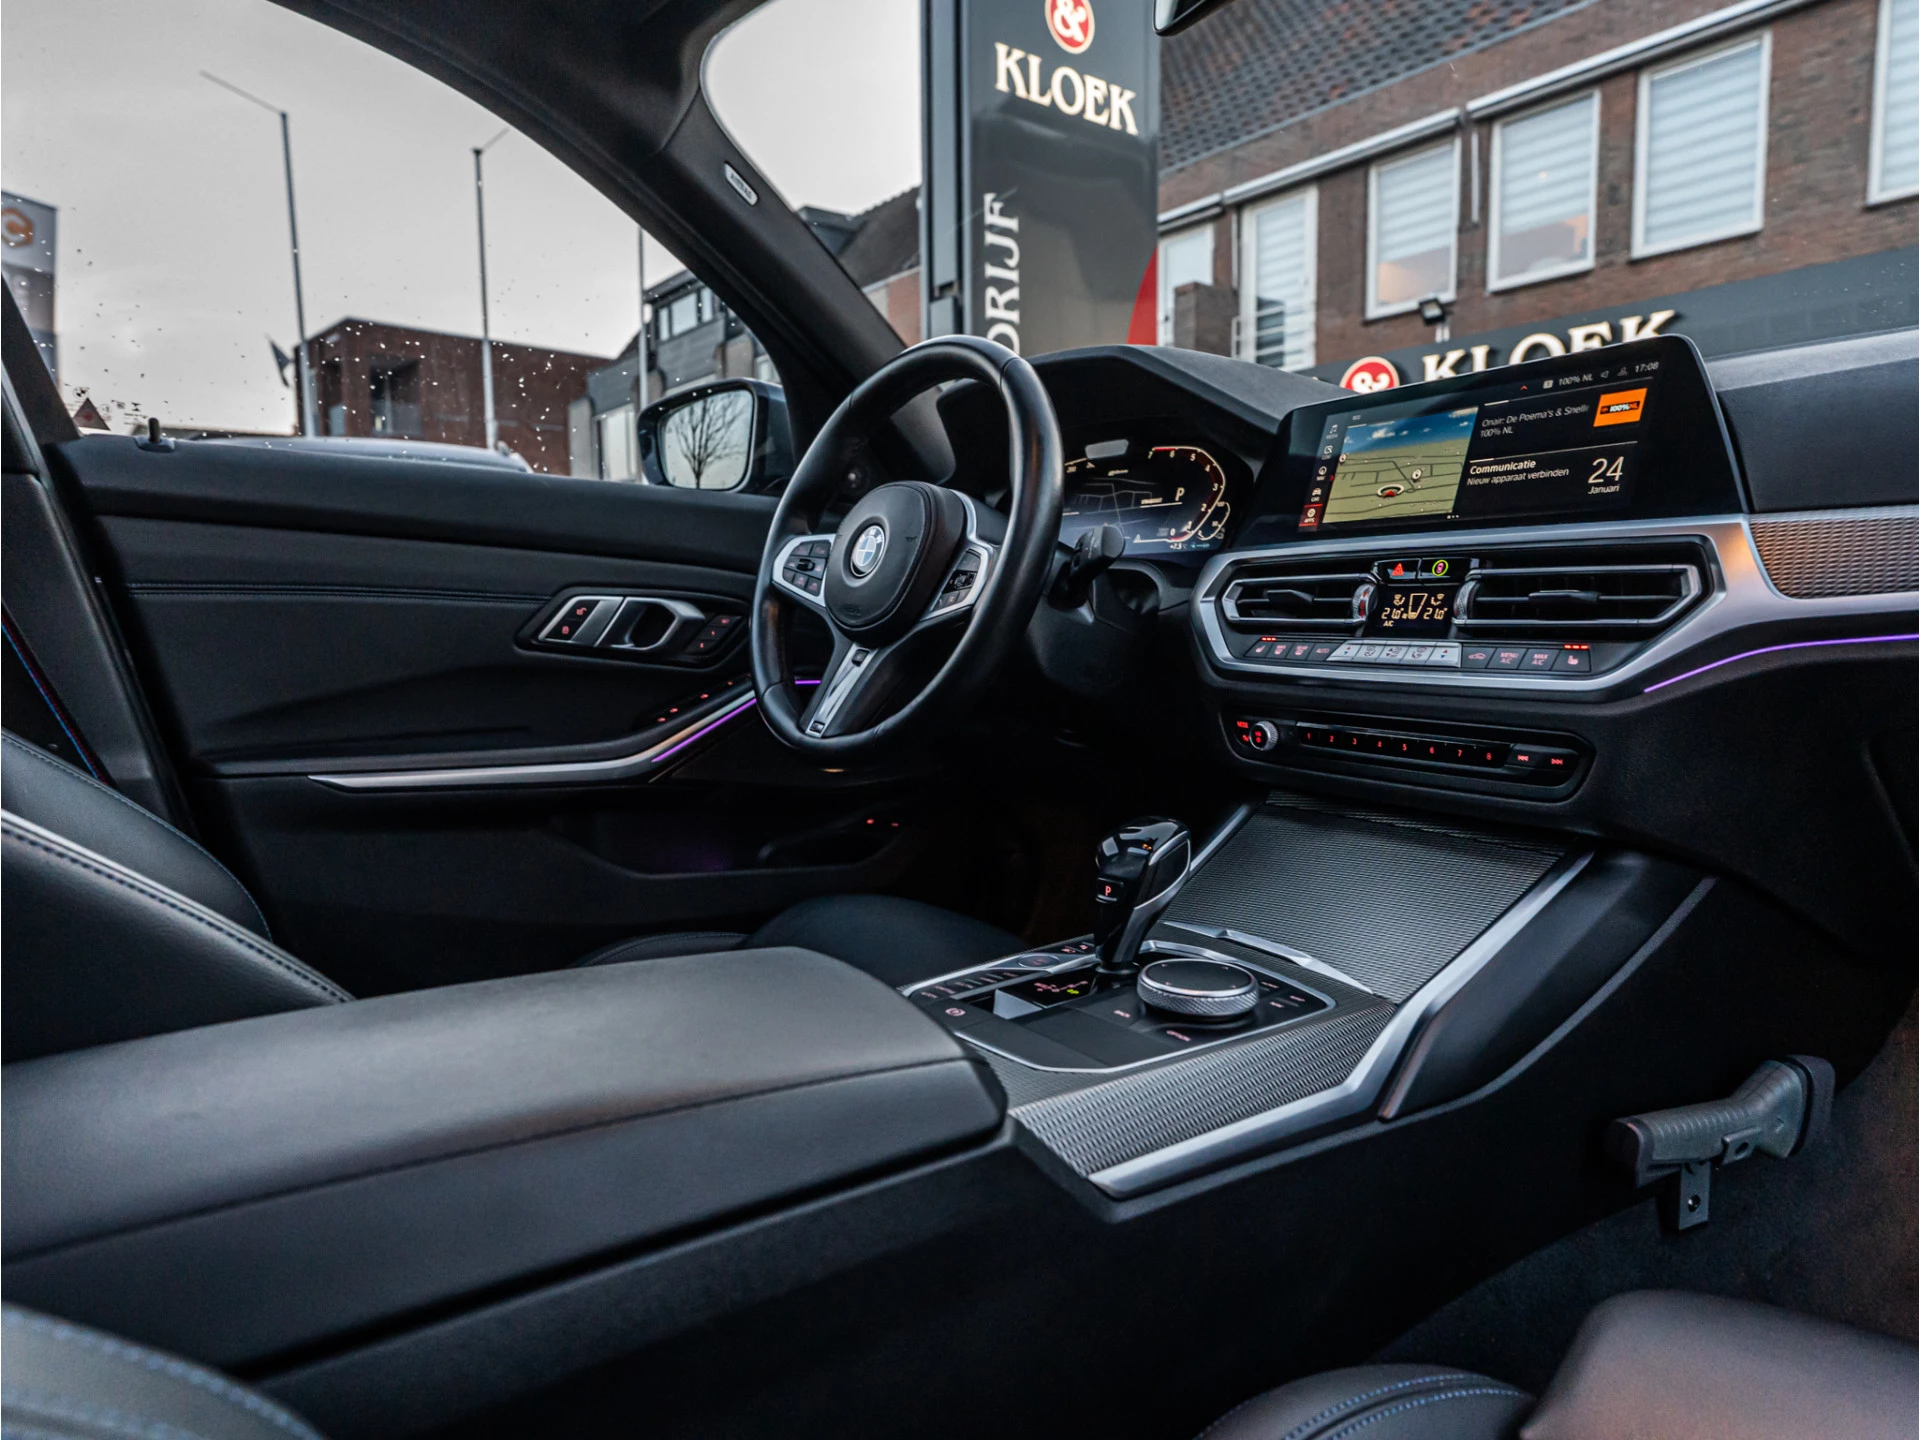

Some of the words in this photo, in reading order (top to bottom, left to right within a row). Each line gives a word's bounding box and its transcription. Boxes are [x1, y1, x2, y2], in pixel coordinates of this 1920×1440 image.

[994, 42, 1138, 136] KLOEK
[1635, 361, 1659, 373] 17:08
[1506, 415, 1518, 424] De
[1190, 453, 1196, 462] 5
[1205, 464, 1211, 473] 4
[1469, 459, 1537, 475] Communicatie
[1587, 456, 1625, 485] 24
[1467, 477, 1491, 486] Nieuw
[1491, 472, 1527, 484] apparaat
[1527, 467, 1570, 480] verbinden
[1212, 483, 1218, 492] 3
[1587, 483, 1620, 496] Januari
[1175, 487, 1185, 502] P
[1200, 503, 1207, 512] 2
[1329, 735, 1334, 743] 2
[1352, 737, 1358, 745] 3
[1377, 740, 1382, 748] 4
[1402, 743, 1407, 751] 5
[1429, 746, 1434, 754] 6
[1457, 749, 1463, 757] 7
[1104, 885, 1112, 897] P
